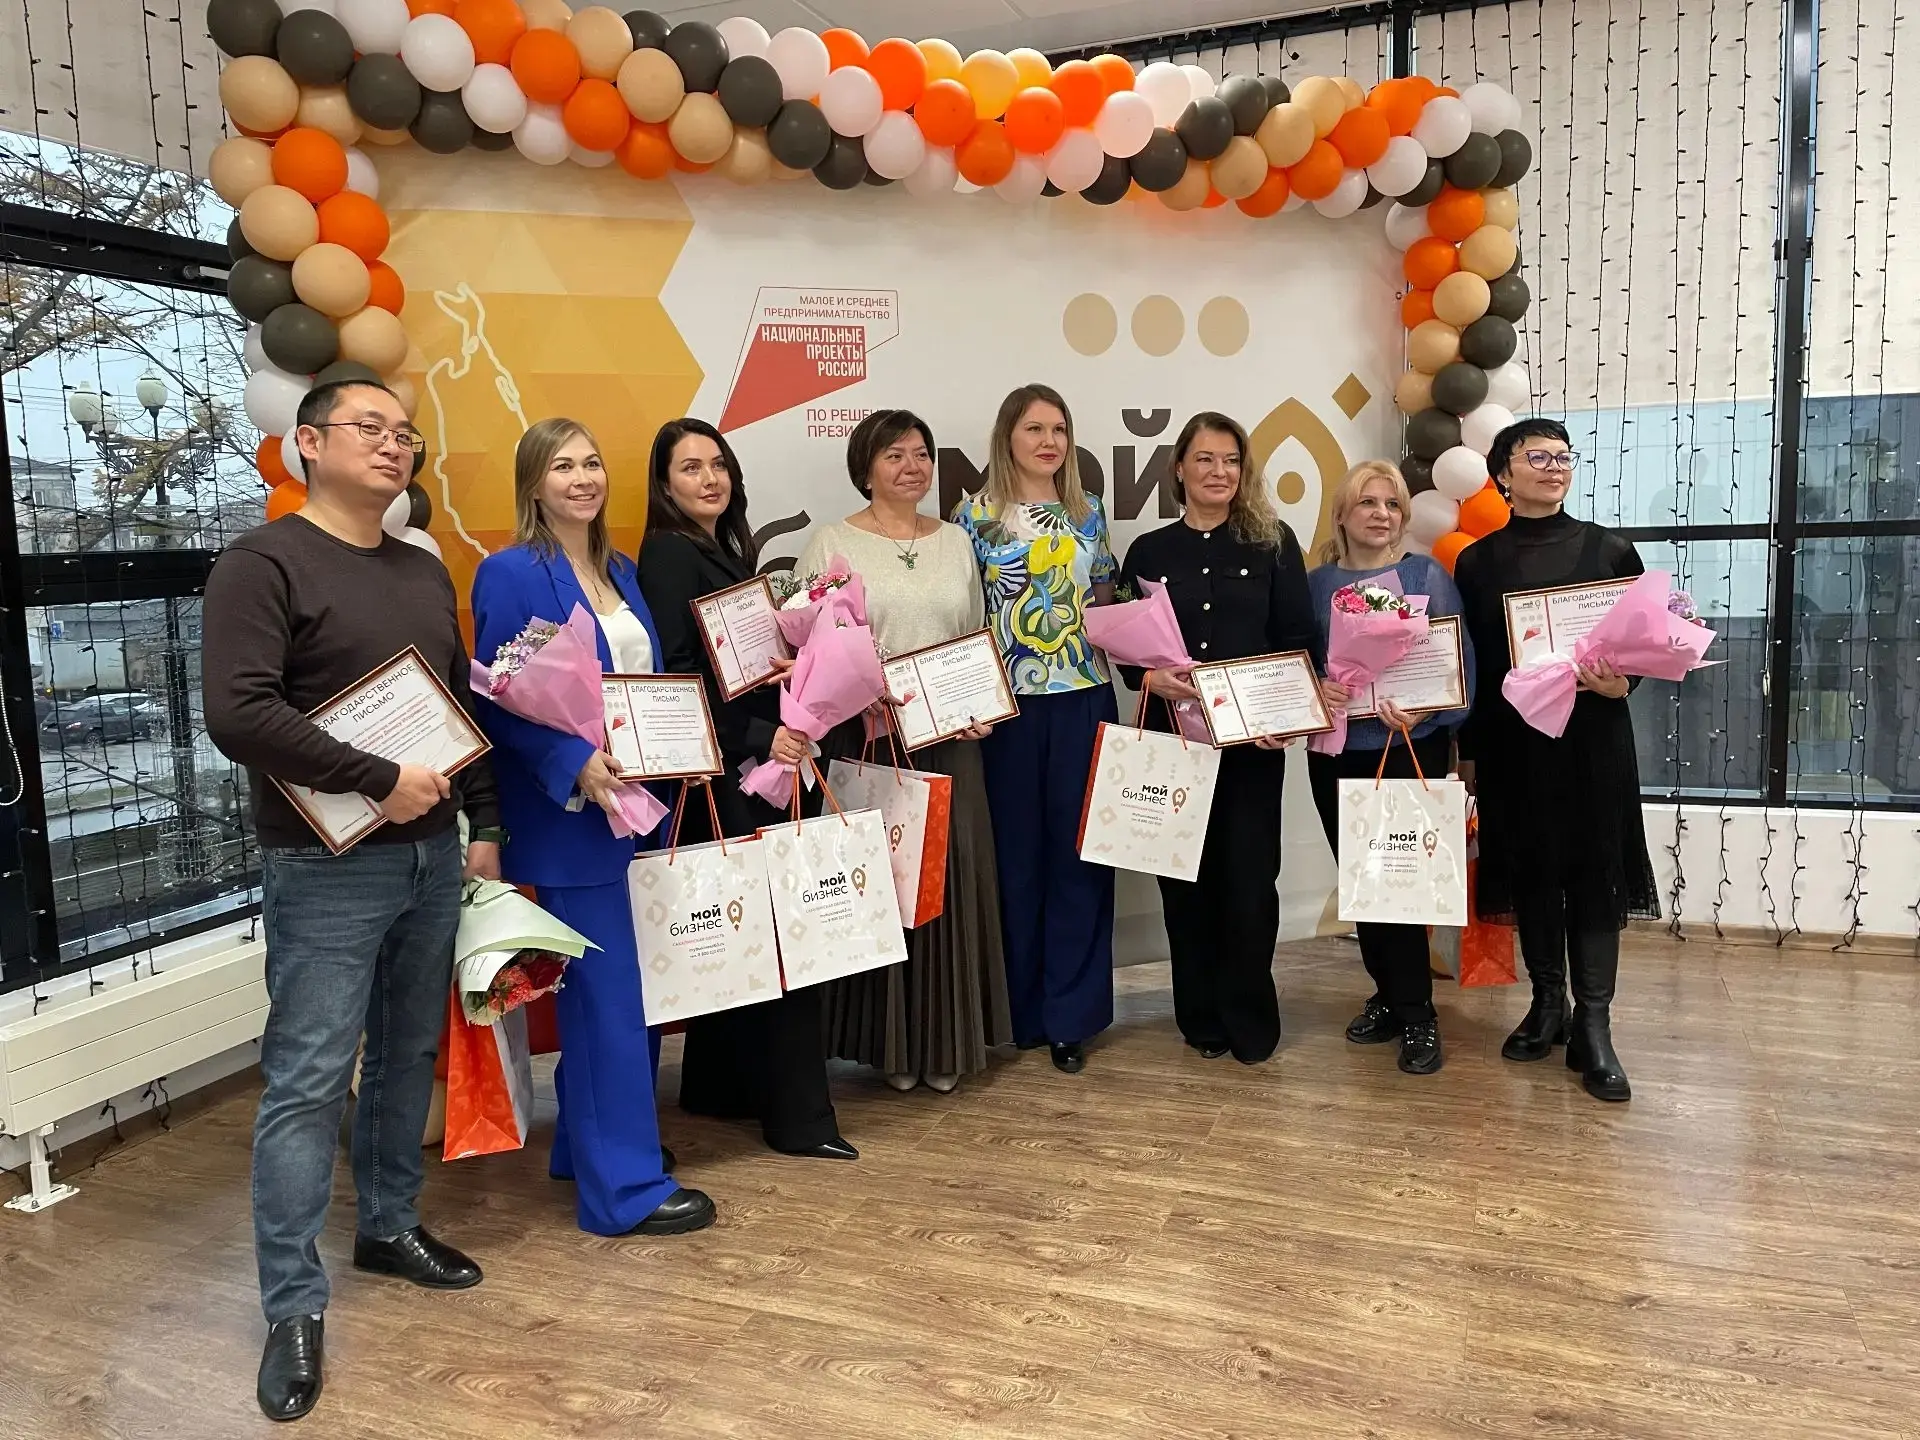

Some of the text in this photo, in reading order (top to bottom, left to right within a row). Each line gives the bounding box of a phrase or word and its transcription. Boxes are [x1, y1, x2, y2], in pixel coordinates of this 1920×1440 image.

[800, 296, 889, 307] МАЛОЕ И СРЕДНЕЕ
[764, 308, 889, 319] ПРЕДПРИНИМАТЕЛЬСТВО
[762, 326, 862, 343] НАЦИОНАЛЬНЫЕ
[807, 344, 863, 360] ПРОЕКТЫ
[818, 361, 864, 377] РОССИИ
[807, 409, 826, 421] ПО
[808, 425, 853, 437] ПРЕЗИ
[1578, 599, 1615, 609] ПИСЬМО
[920, 639, 988, 665] БЛАГОДАРСТВЕННОЕ
[942, 653, 971, 667] ПИСЬМО
[1231, 660, 1302, 676] БЛАГОДАРСТВЕННОЕ
[1254, 671, 1283, 680] ПИСЬМО
[318, 663, 415, 731] БЛАГОДАРСТВЕННОЕ
[352, 691, 395, 723] ПИСЬМО
[1122, 788, 1167, 806] бизнес
[1142, 785, 1168, 796] мой
[1389, 831, 1417, 842] мой
[1369, 839, 1417, 852] бизнес
[819, 872, 846, 888] мой
[803, 886, 848, 903] бизнес
[691, 904, 721, 921] мой
[670, 919, 723, 936] бизнес
